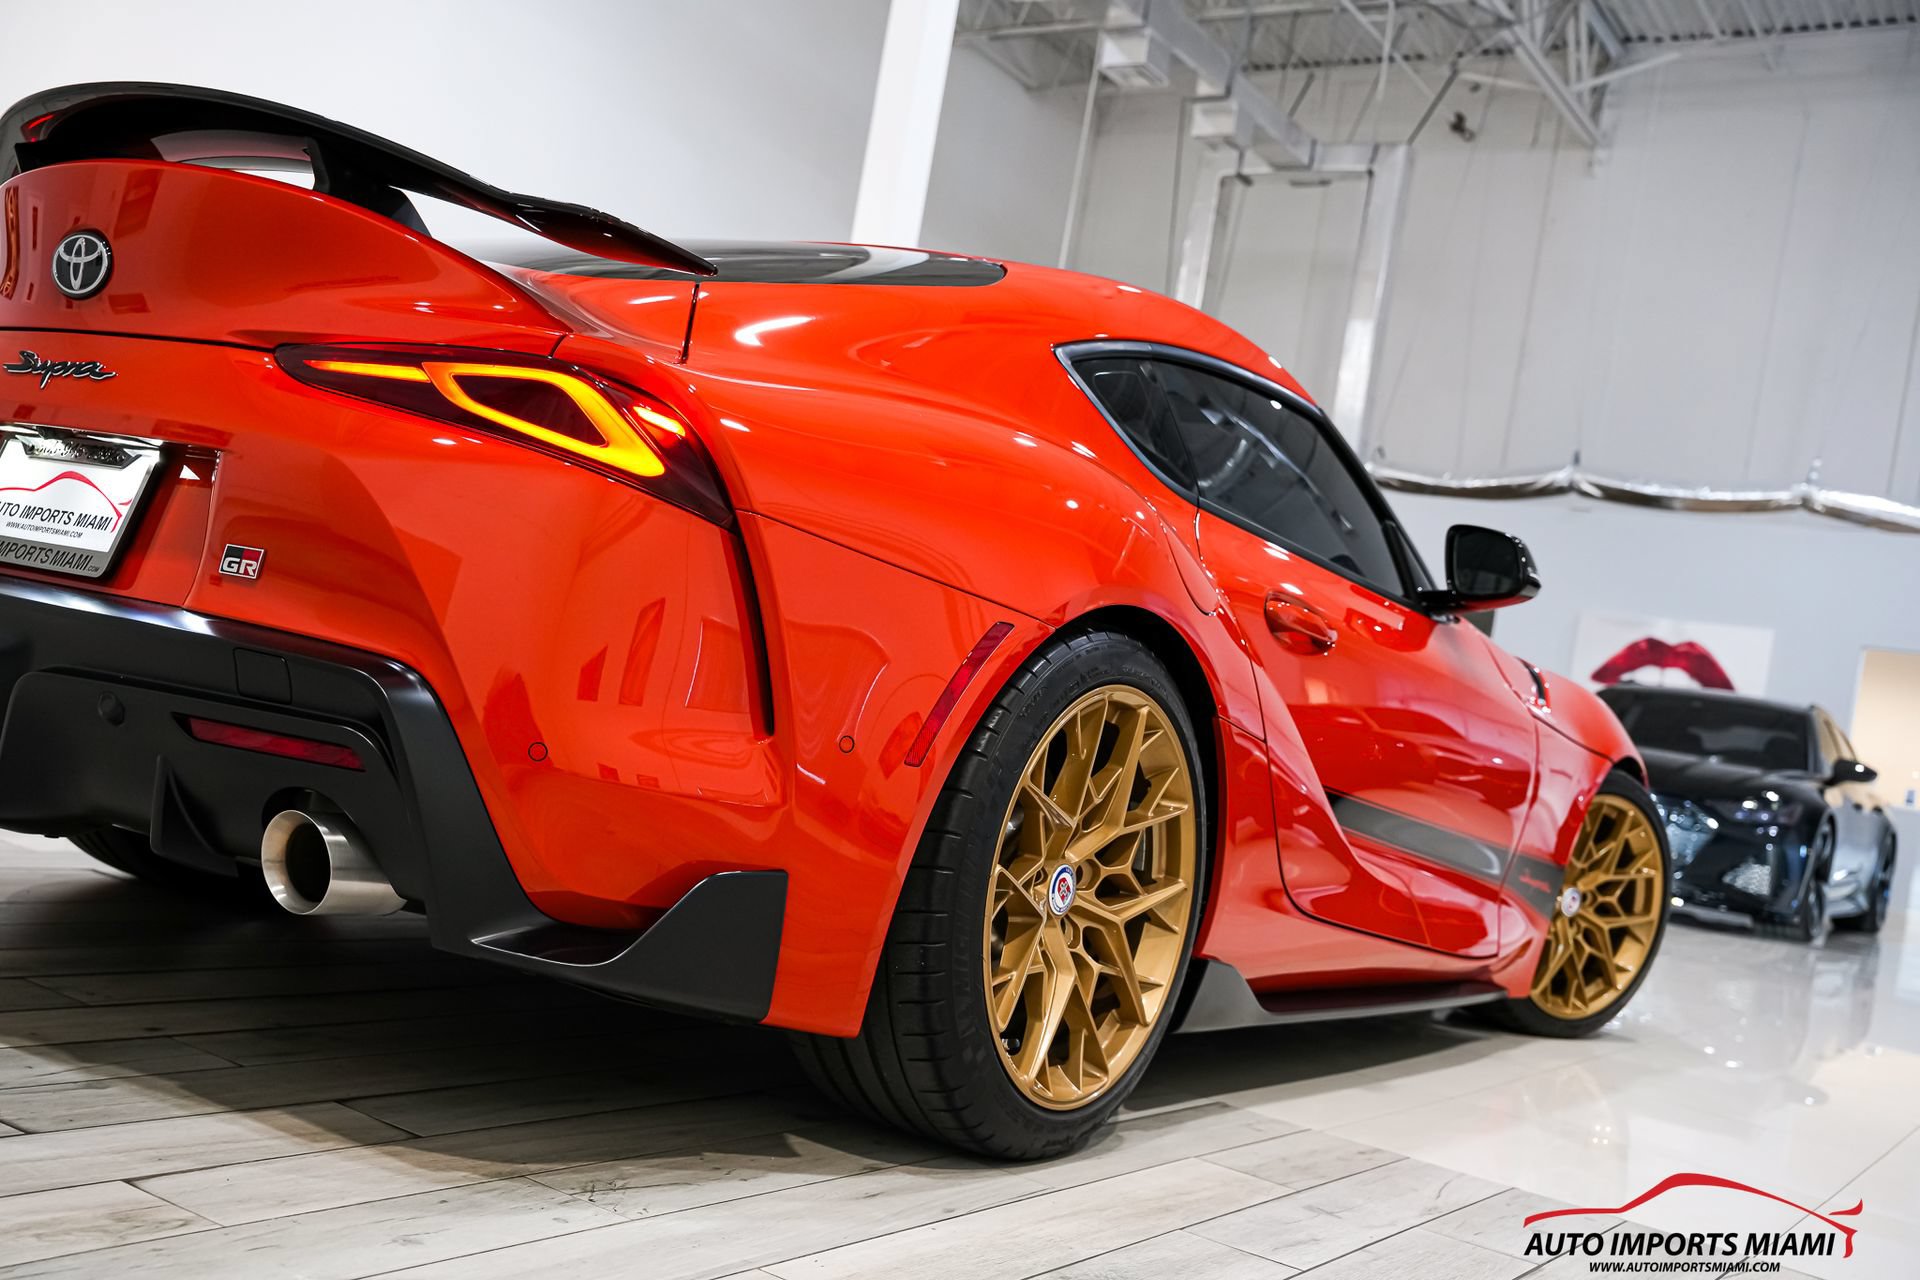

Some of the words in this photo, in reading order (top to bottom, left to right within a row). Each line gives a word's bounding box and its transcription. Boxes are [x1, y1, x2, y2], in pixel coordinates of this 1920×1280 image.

[3, 350, 118, 389] Supra
[19, 504, 74, 526] IMPORTS
[73, 513, 113, 531] MIAMI
[222, 556, 258, 576] GR
